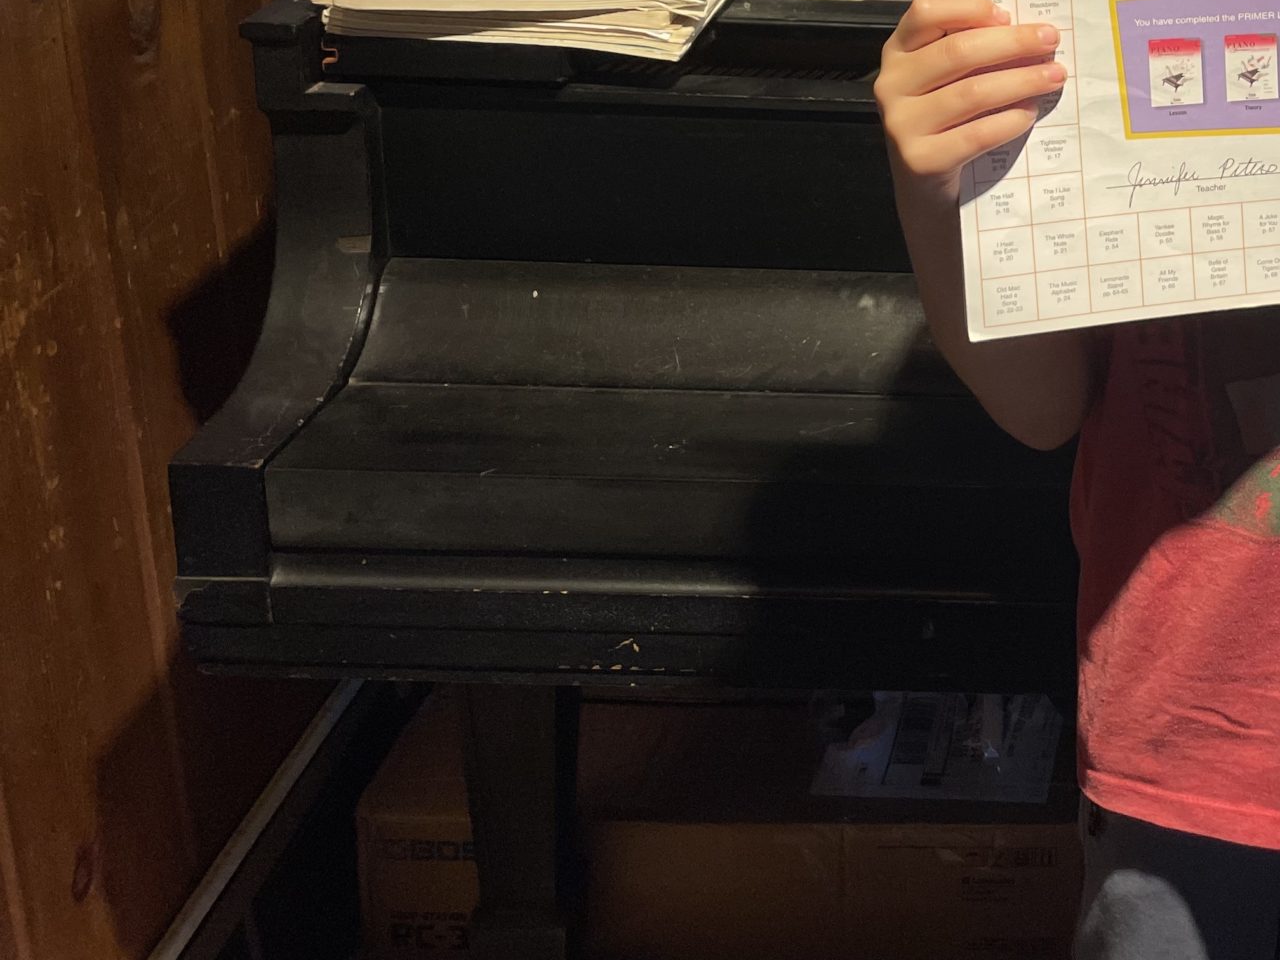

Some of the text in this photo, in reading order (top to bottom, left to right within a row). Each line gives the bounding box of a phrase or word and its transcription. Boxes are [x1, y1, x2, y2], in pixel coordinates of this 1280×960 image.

[1134, 18, 1150, 27] You
[1153, 17, 1173, 25] have
[1176, 15, 1220, 26] completed
[1222, 14, 1236, 22] the
[1238, 11, 1275, 21] PRIMER
[1195, 184, 1227, 193] Teacher
